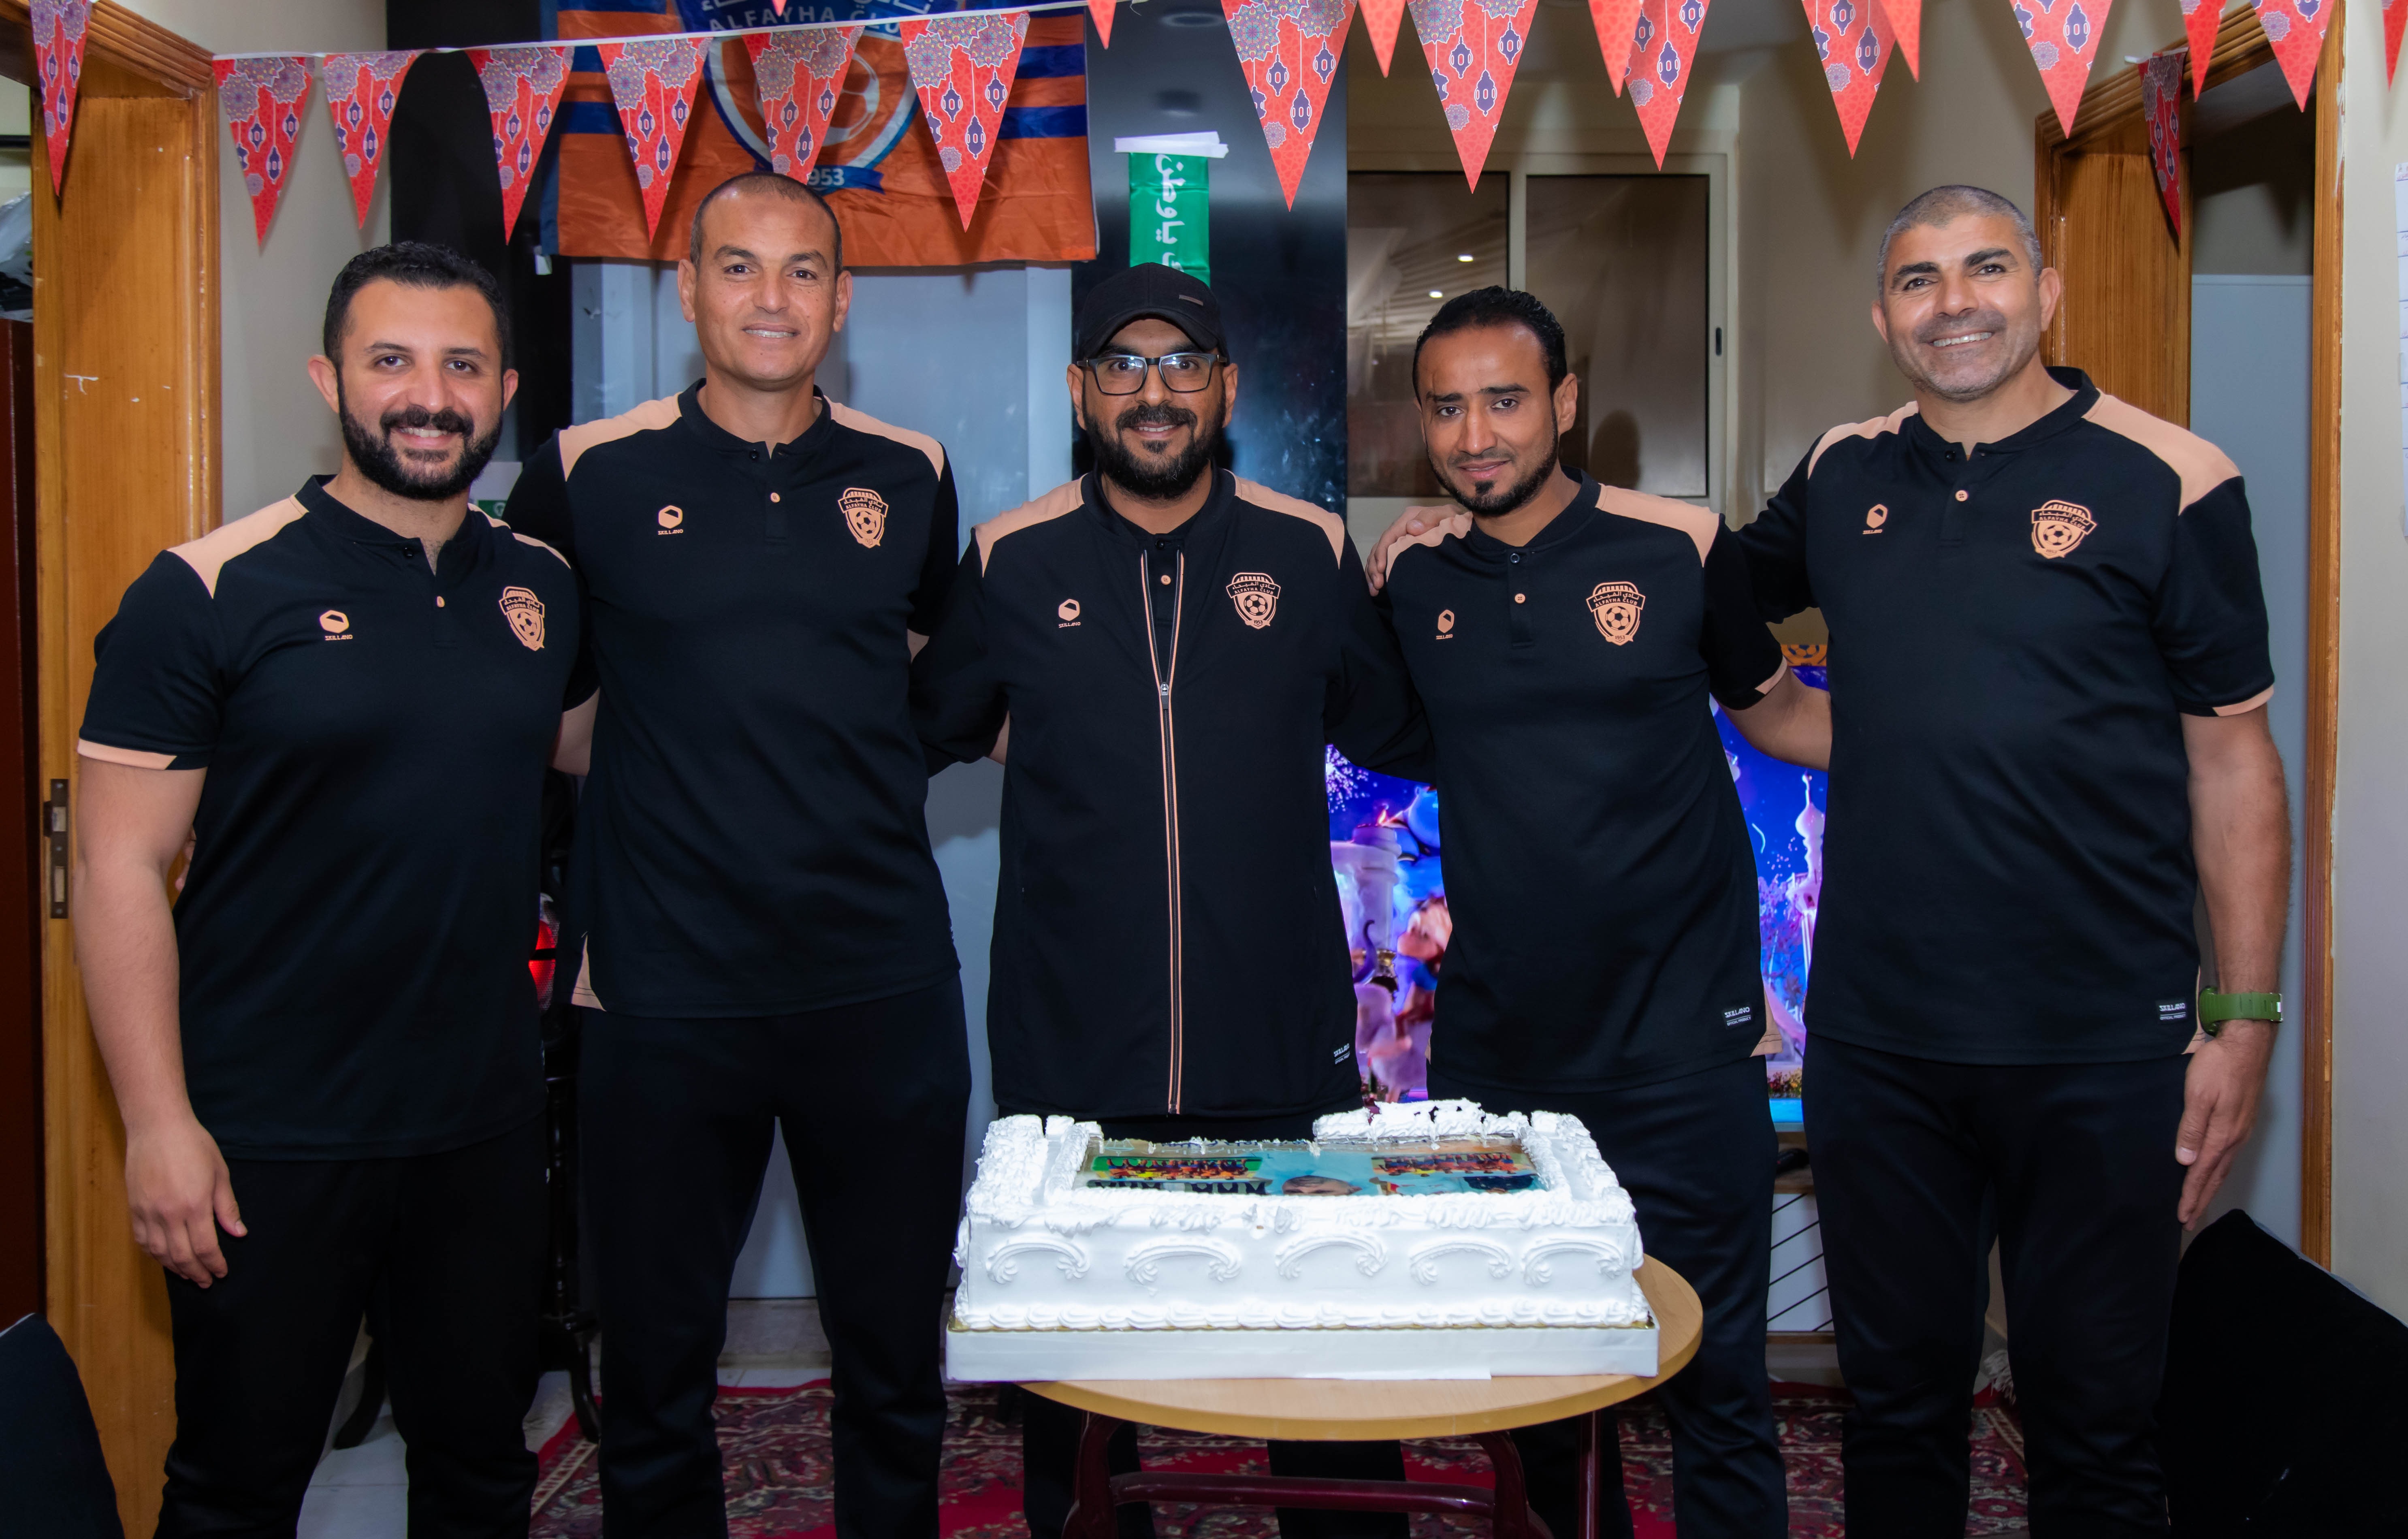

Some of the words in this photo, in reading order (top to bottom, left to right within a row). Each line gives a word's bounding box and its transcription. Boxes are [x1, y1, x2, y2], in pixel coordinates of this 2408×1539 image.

[710, 6, 836, 32] ALFAYHA
[808, 168, 845, 186] 953
[868, 505, 882, 513] CLUB
[2070, 520, 2086, 530] CLUB
[1595, 598, 1621, 608] ALFAYHA
[1724, 1007, 1750, 1018] SKILLANO
